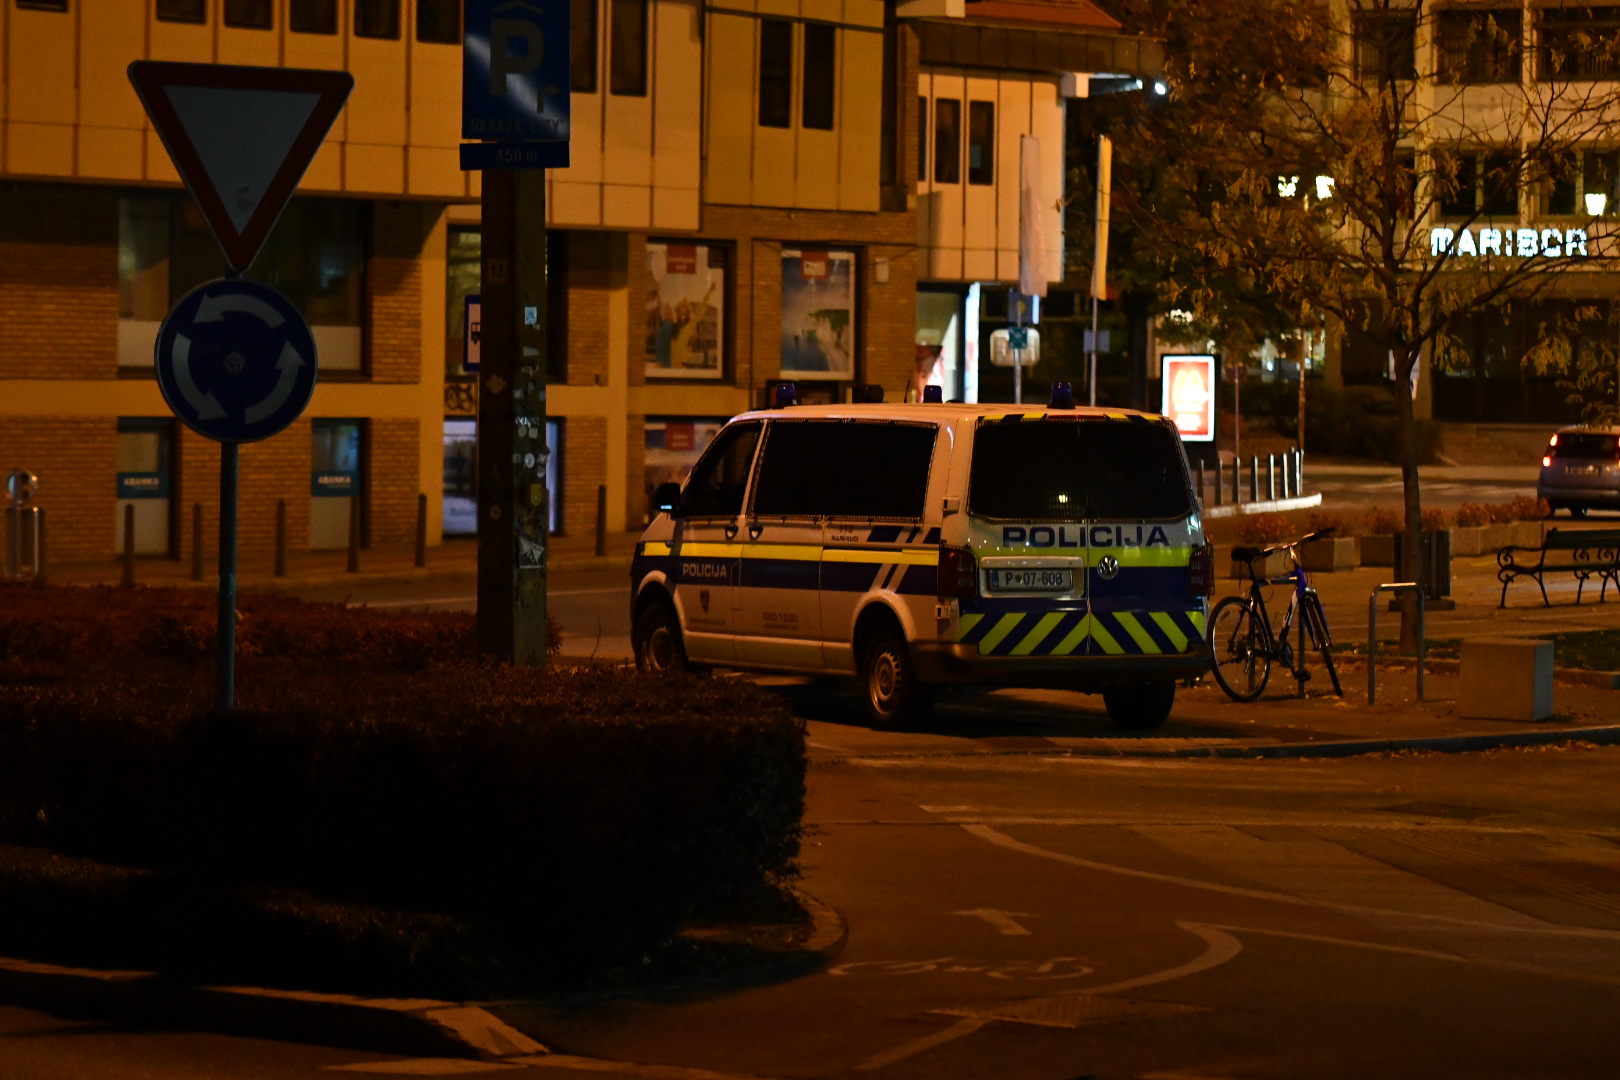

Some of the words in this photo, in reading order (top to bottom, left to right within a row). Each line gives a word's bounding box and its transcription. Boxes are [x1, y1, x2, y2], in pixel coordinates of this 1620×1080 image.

[489, 18, 545, 96] P
[496, 148, 522, 162] 450
[526, 151, 538, 161] m
[1430, 227, 1588, 257] MARIBOR
[1002, 526, 1170, 548] POLICIJA
[682, 563, 727, 578] POLICIJA
[1005, 571, 1013, 586] P
